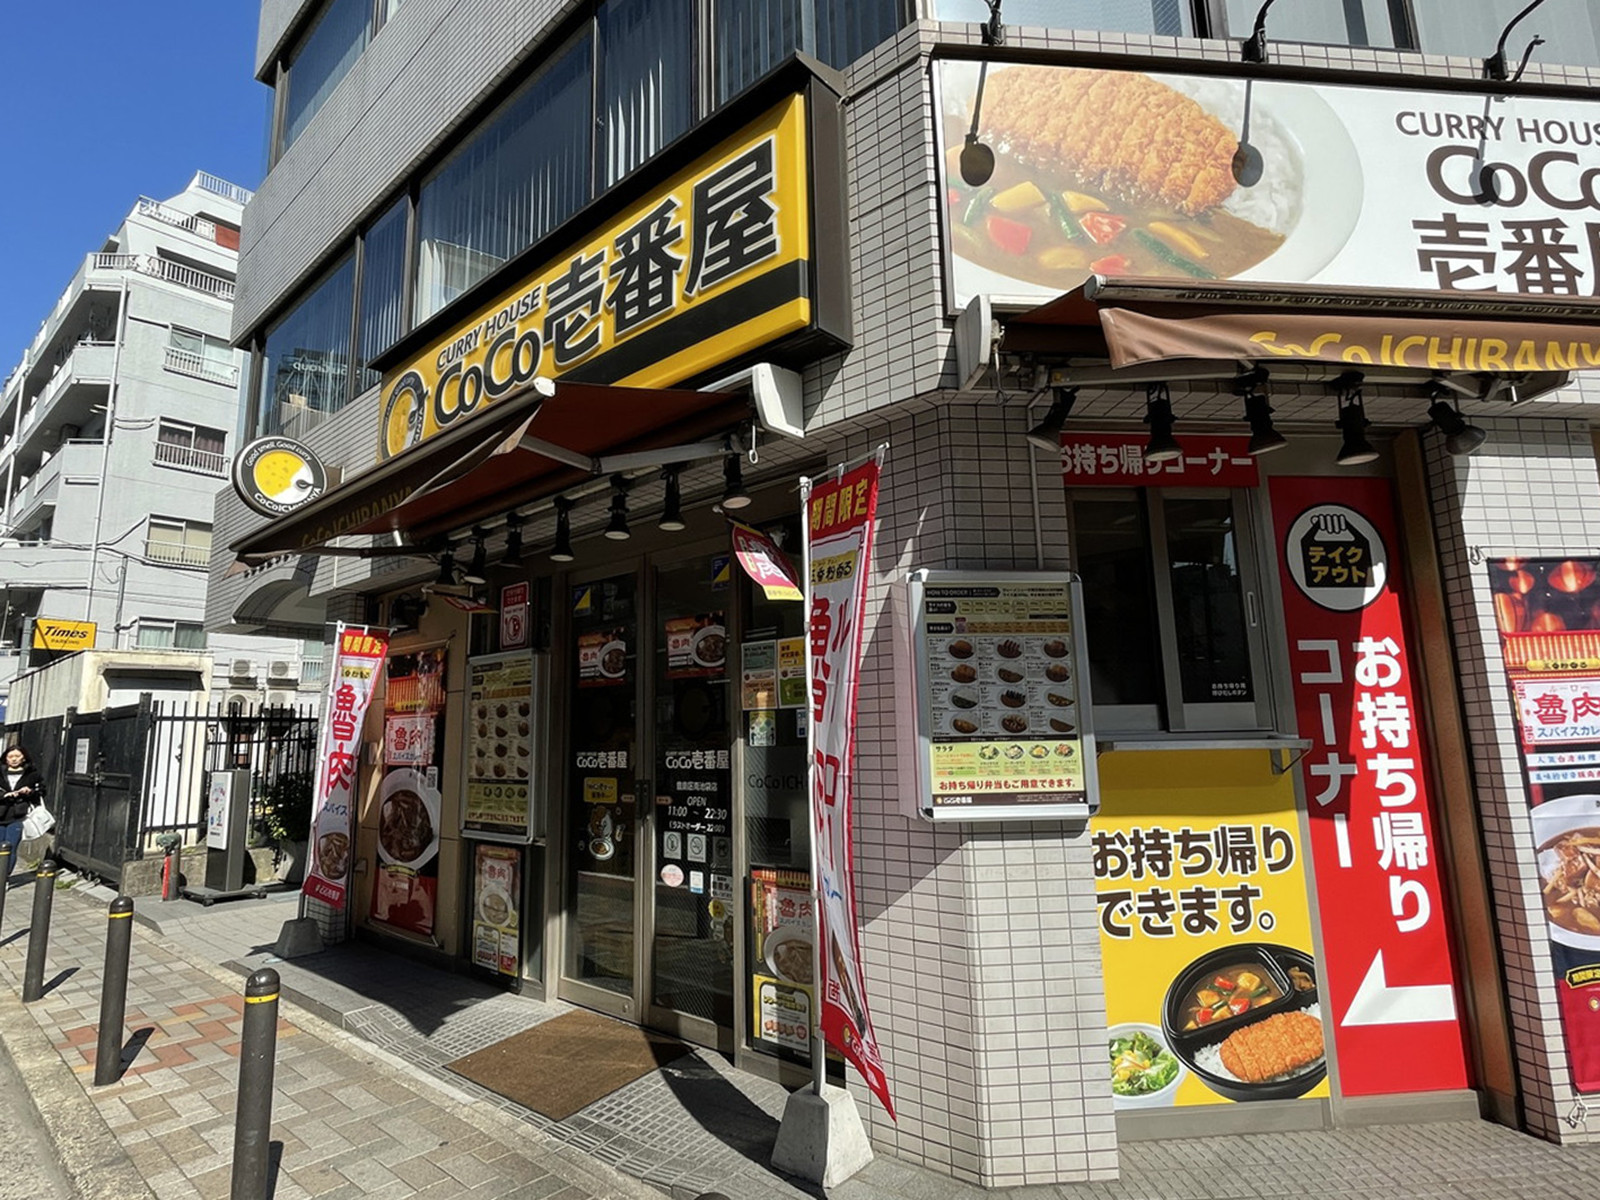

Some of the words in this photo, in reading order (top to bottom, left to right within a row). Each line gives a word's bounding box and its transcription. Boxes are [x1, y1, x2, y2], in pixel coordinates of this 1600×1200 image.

[1396, 111, 1504, 141] CURRY
[1412, 212, 1600, 297] 壱番
[433, 134, 781, 427] CoCo壱番屋
[436, 322, 482, 370] CURRY
[483, 283, 545, 342] HOUSE
[245, 448, 259, 467] Good
[276, 440, 297, 450] Good
[295, 446, 312, 461] curry
[811, 478, 868, 531] 期間限定
[1308, 546, 1362, 564] テイク
[1311, 565, 1366, 584] アウト
[44, 625, 89, 639] Times
[1532, 691, 1600, 726] 魯肉
[1297, 638, 1358, 869] コーナー
[686, 796, 708, 807] OPEN
[939, 778, 1076, 790] お持ち帰り弁当もご用意できます。
[1353, 635, 1431, 933] お持ち帰り
[667, 805, 688, 817] 11:00
[703, 807, 728, 820] 22:30
[1091, 825, 1296, 879] お持ち帰り
[1096, 884, 1275, 937] できます。
